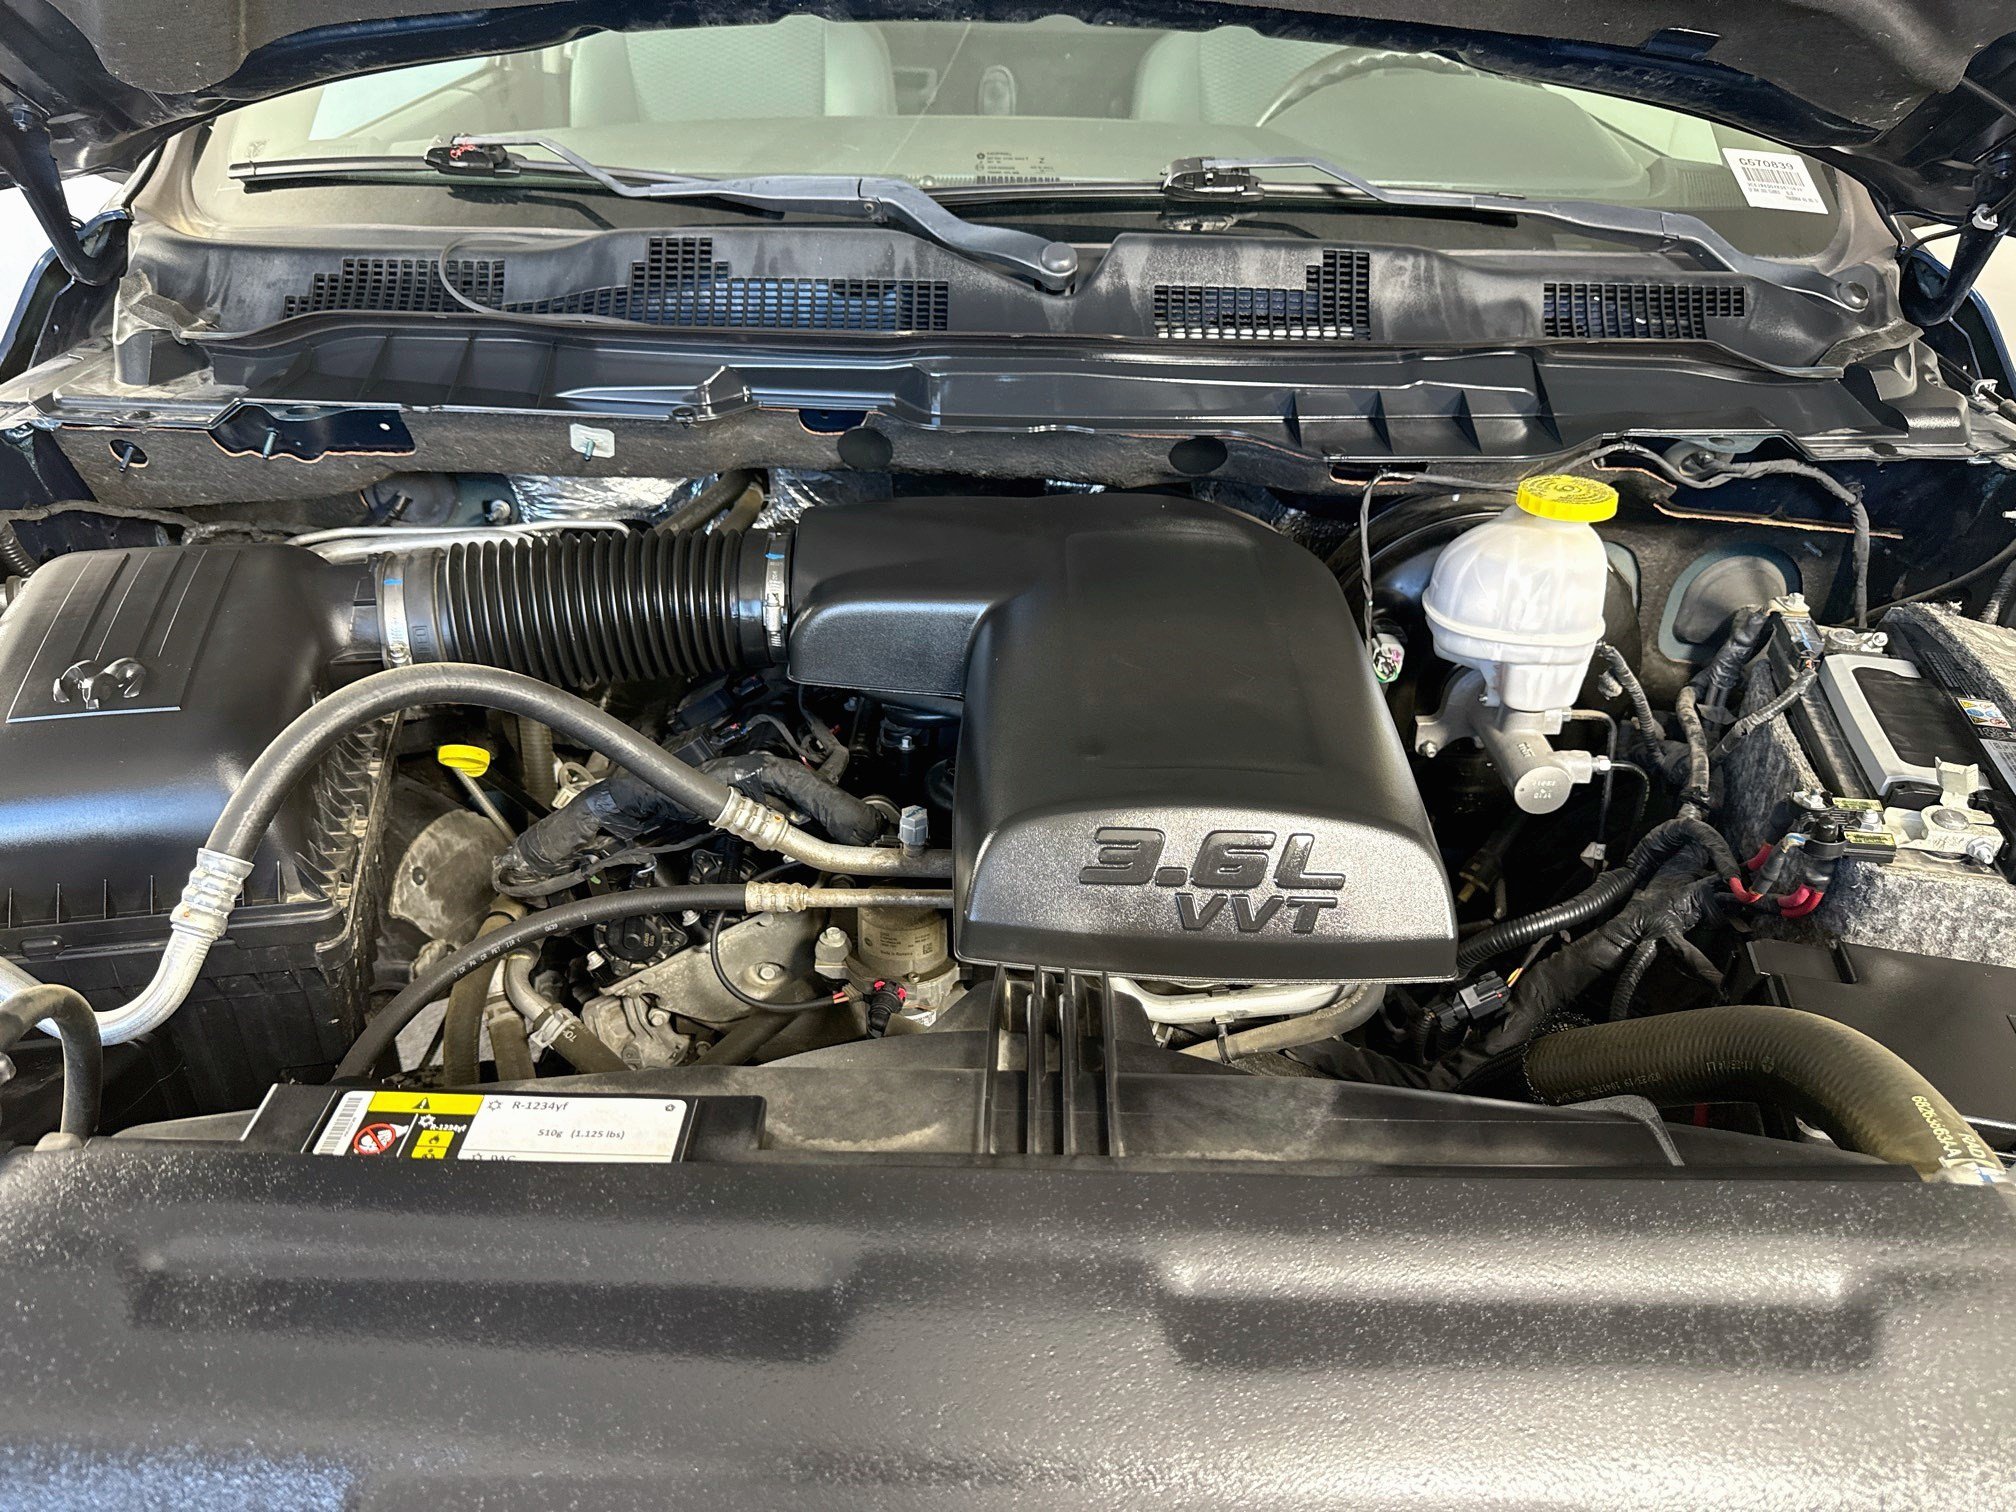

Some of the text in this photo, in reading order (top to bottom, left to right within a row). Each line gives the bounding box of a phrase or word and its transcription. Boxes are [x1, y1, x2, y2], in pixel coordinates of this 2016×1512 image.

[1079, 827, 1346, 890] 3.6L
[1175, 892, 1338, 933] VVT
[512, 1101, 569, 1112] R-1234yf
[538, 1129, 625, 1140] 510g (1.125 lbs)
[1958, 1133, 1987, 1159] RAD
